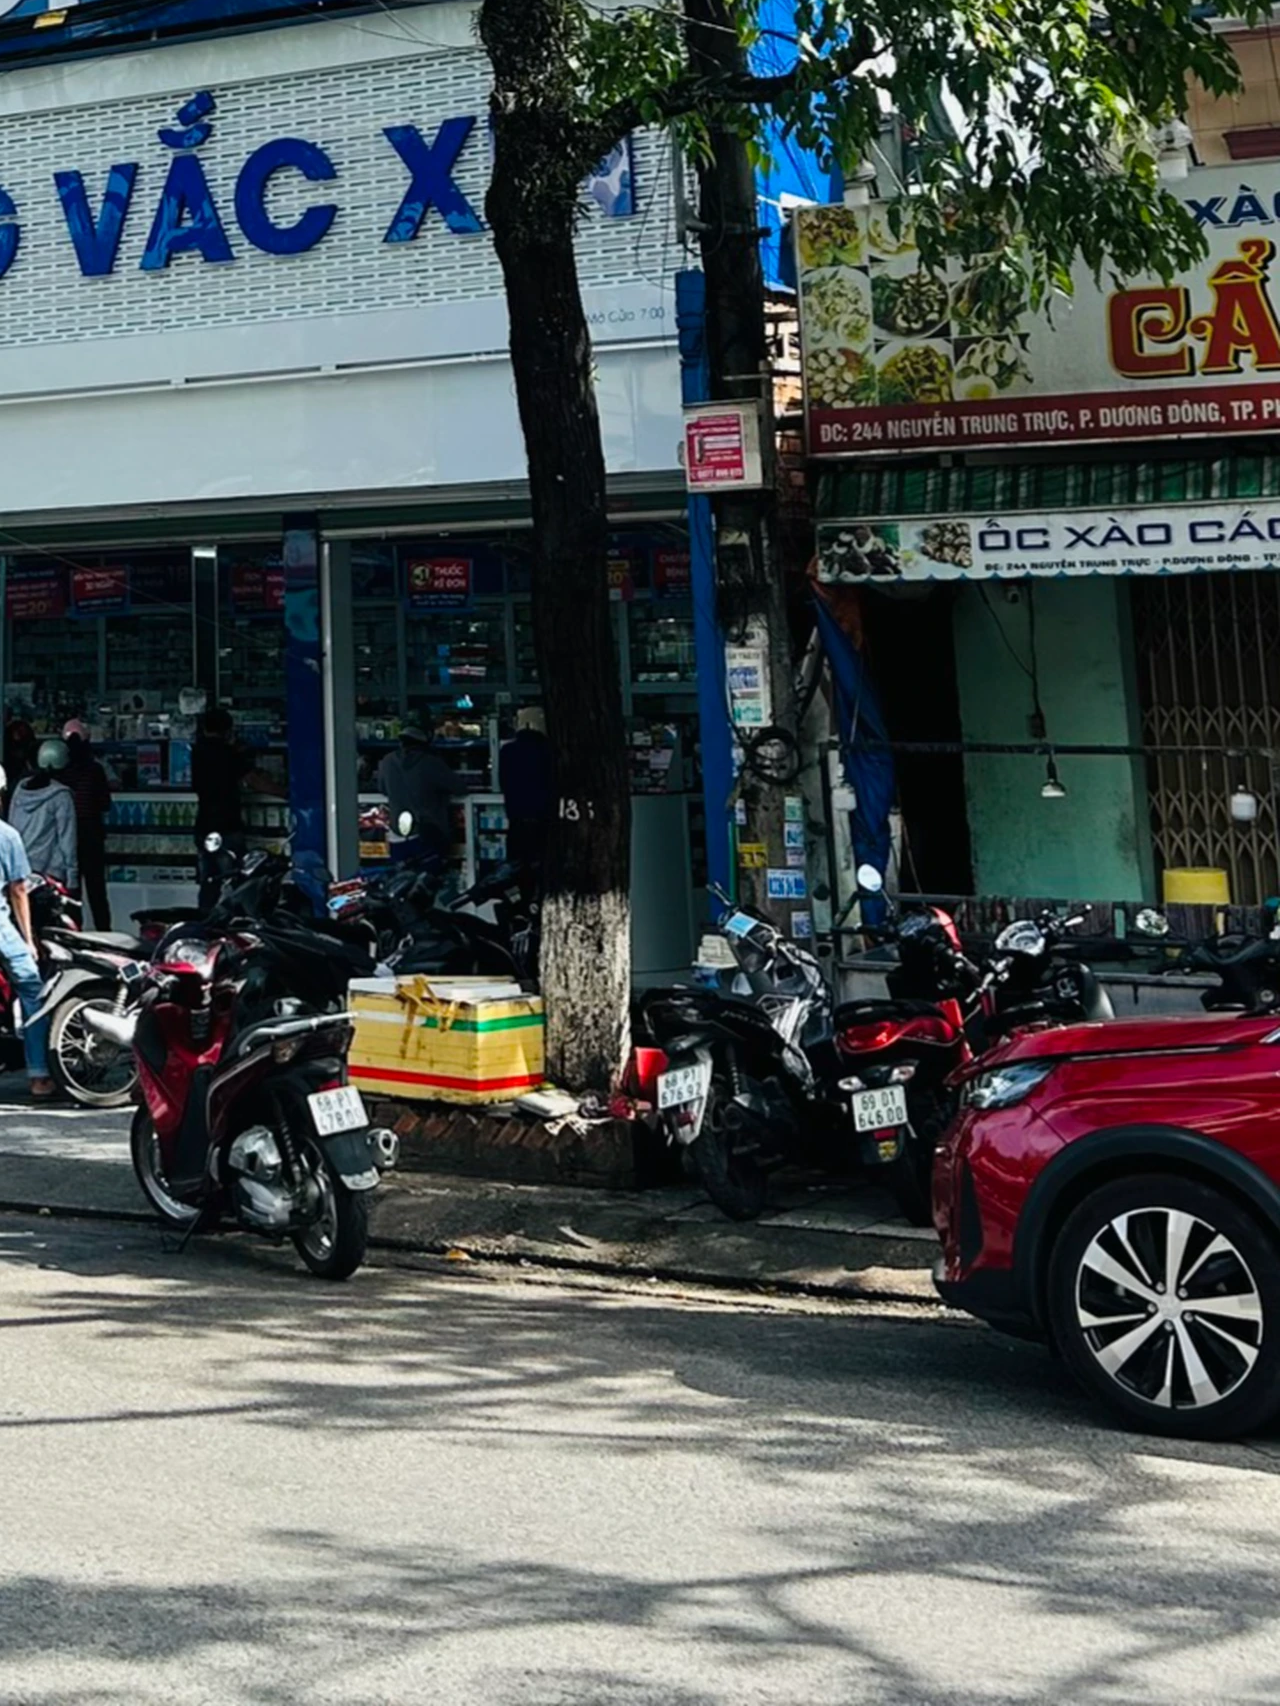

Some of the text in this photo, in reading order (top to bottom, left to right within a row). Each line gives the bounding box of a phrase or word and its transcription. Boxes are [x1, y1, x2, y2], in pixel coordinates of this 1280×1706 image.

[53, 91, 338, 278] VẮC
[1183, 183, 1280, 226] XÀ
[820, 423, 848, 443] ĐC:
[852, 422, 883, 441] 244
[887, 410, 956, 439] NGUYỄN
[960, 413, 1018, 435] TRUNG
[1023, 409, 1075, 435] TRỰC,
[1079, 408, 1095, 428] P.
[1099, 404, 1163, 427] DƯƠNG
[1167, 398, 1226, 425] ĐÔNG,
[1230, 400, 1257, 421] TP.
[978, 517, 1050, 551] ỐC
[1064, 516, 1172, 549] XÀO
[1006, 562, 1027, 571] 244
[1079, 558, 1118, 568] TRUNG
[1121, 557, 1151, 568] TRỰC
[1217, 552, 1251, 563] ĐÔNG
